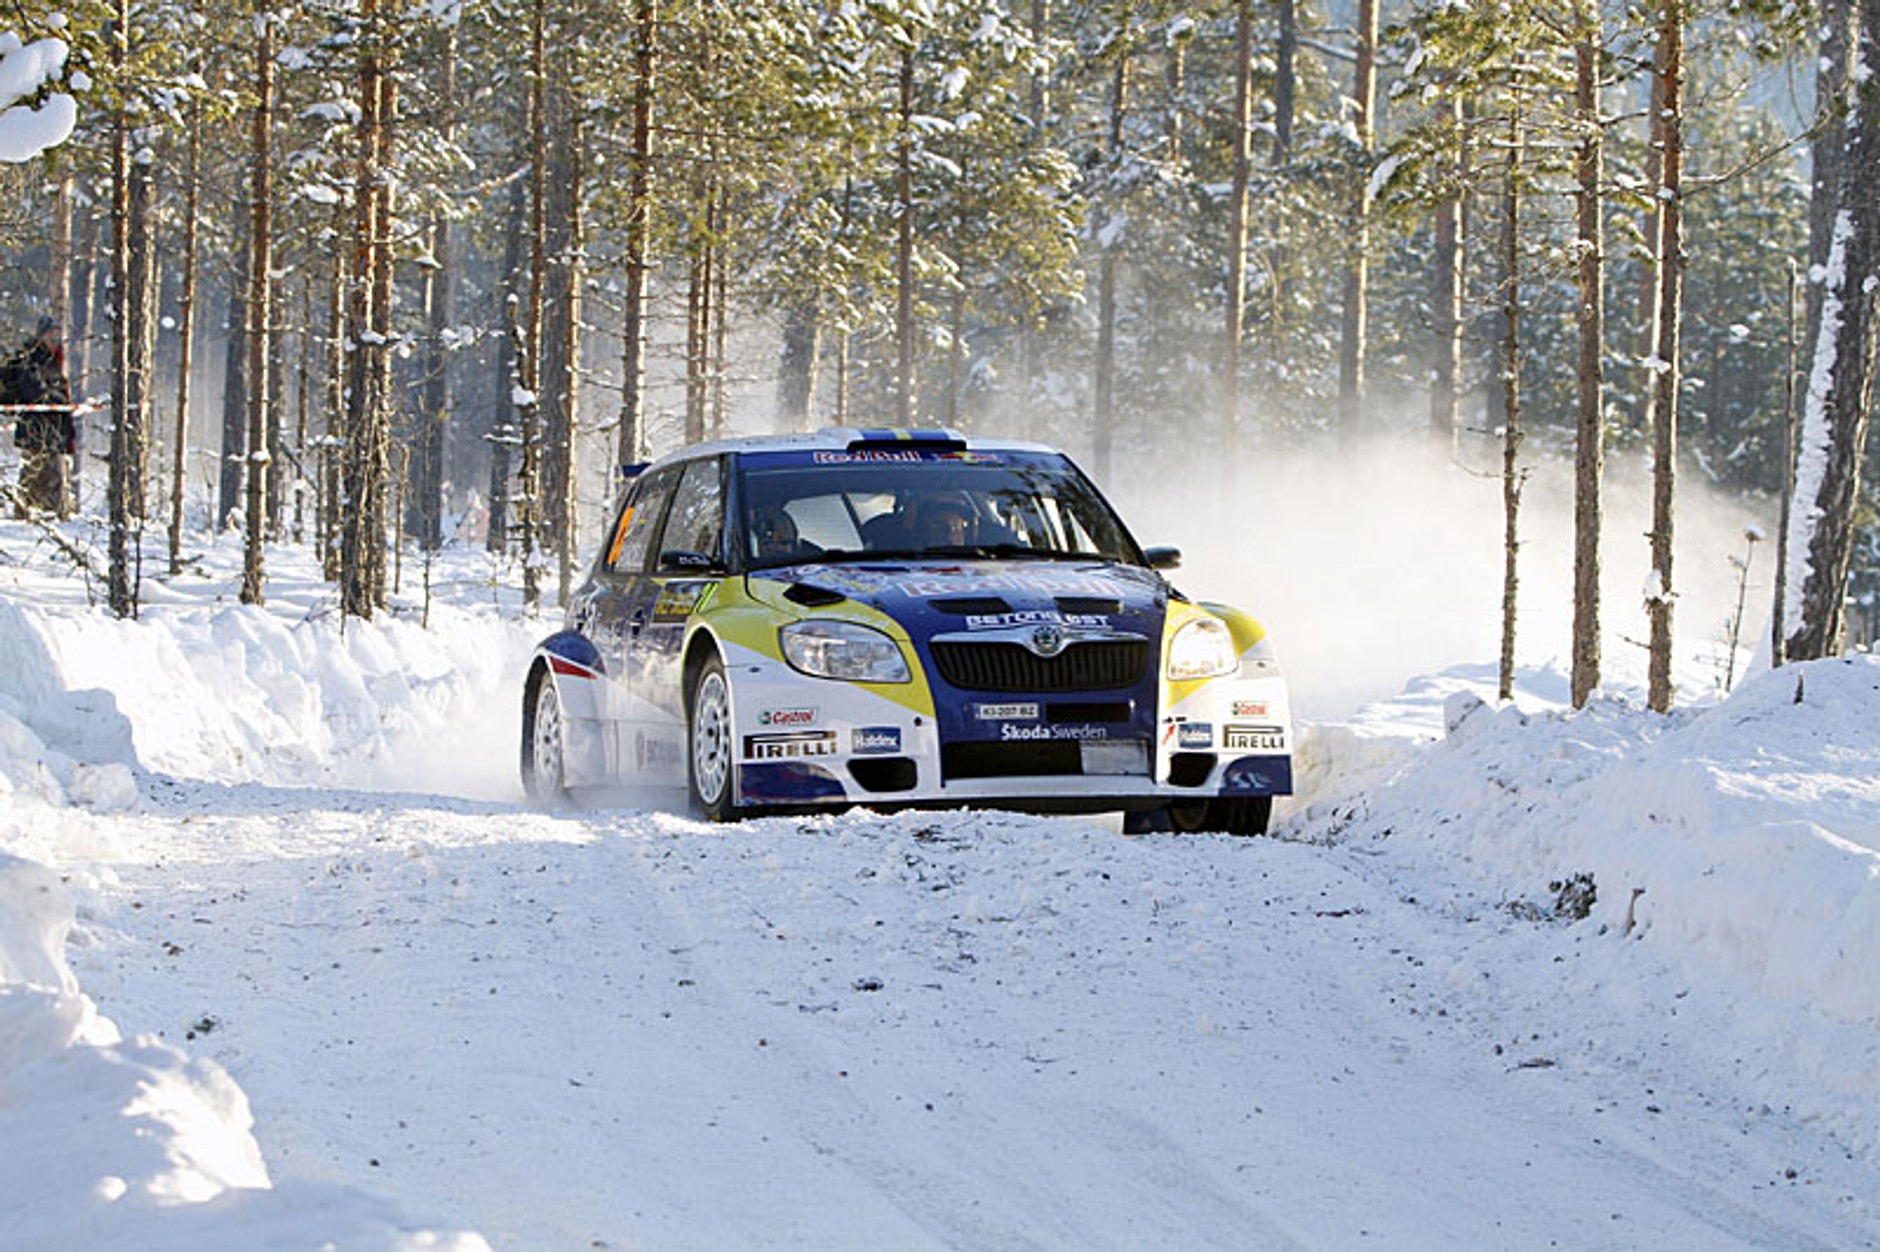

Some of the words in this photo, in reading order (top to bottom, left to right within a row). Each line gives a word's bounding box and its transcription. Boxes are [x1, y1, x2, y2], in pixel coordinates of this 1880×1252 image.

[772, 708, 815, 724] Castrol
[743, 730, 838, 760] PIRELLI
[1222, 723, 1285, 749] PIRELLI
